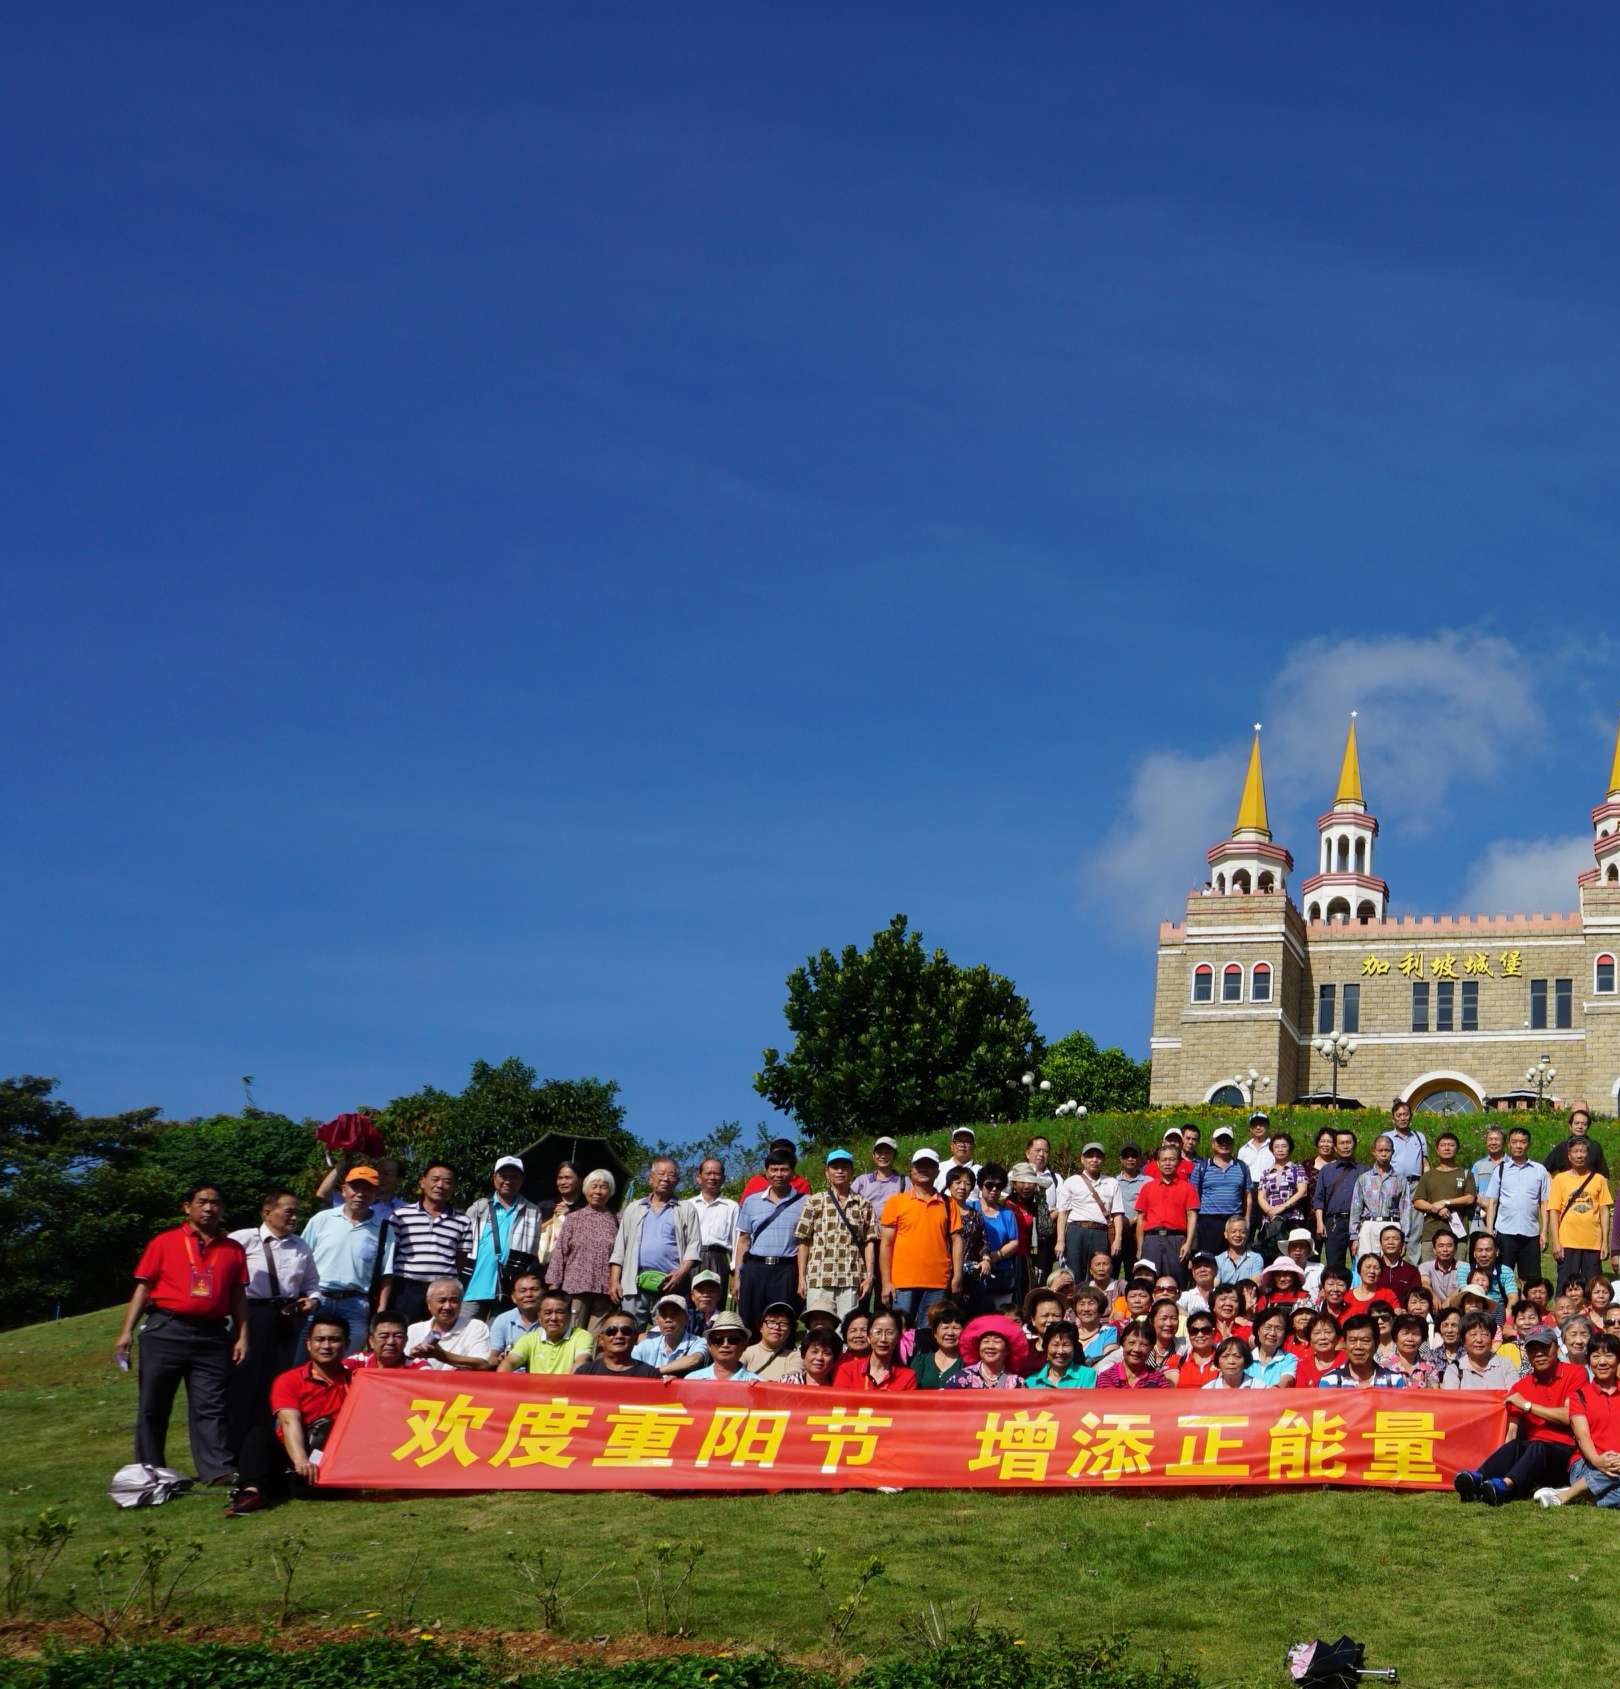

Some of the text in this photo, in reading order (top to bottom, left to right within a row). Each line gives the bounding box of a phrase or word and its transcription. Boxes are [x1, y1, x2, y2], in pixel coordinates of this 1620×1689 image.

[1360, 950, 1523, 979] 加利坡城堡
[391, 1393, 1446, 1483] 欢度重阳节 增添正能量
